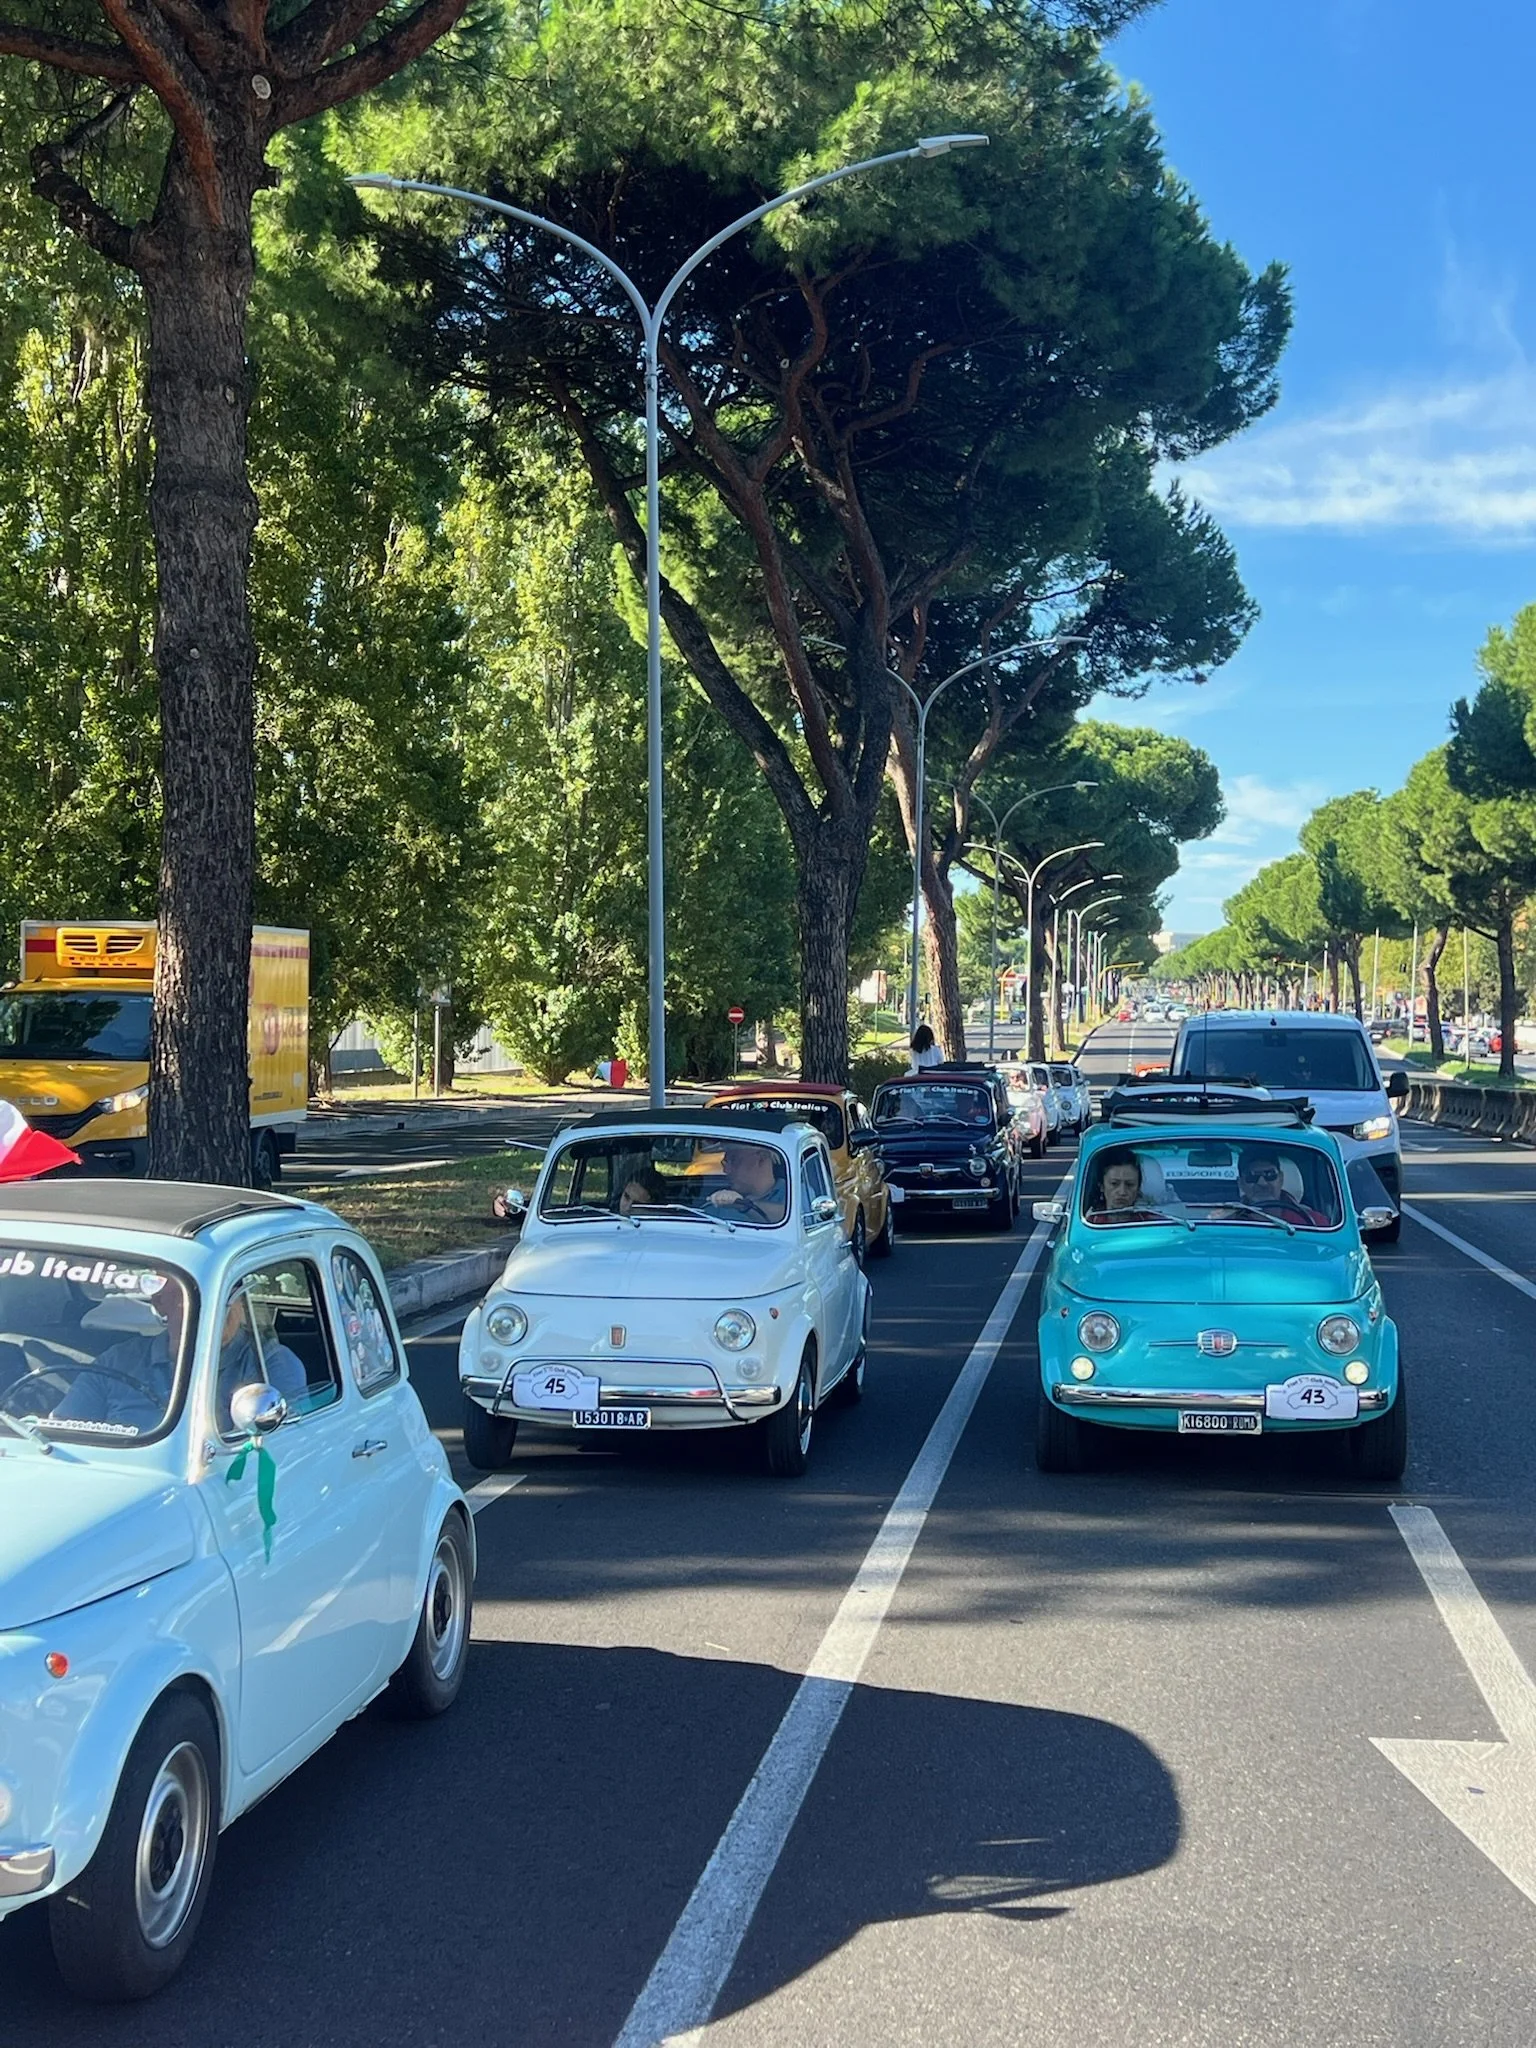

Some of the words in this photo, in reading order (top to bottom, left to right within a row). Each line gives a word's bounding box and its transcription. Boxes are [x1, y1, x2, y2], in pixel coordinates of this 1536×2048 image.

[731, 1102, 750, 1111] Fiat
[770, 1101, 792, 1110] Club
[793, 1102, 820, 1112] Italia
[40, 1257, 139, 1289] Italia
[545, 1377, 566, 1394] 45
[1301, 1388, 1325, 1404] 43
